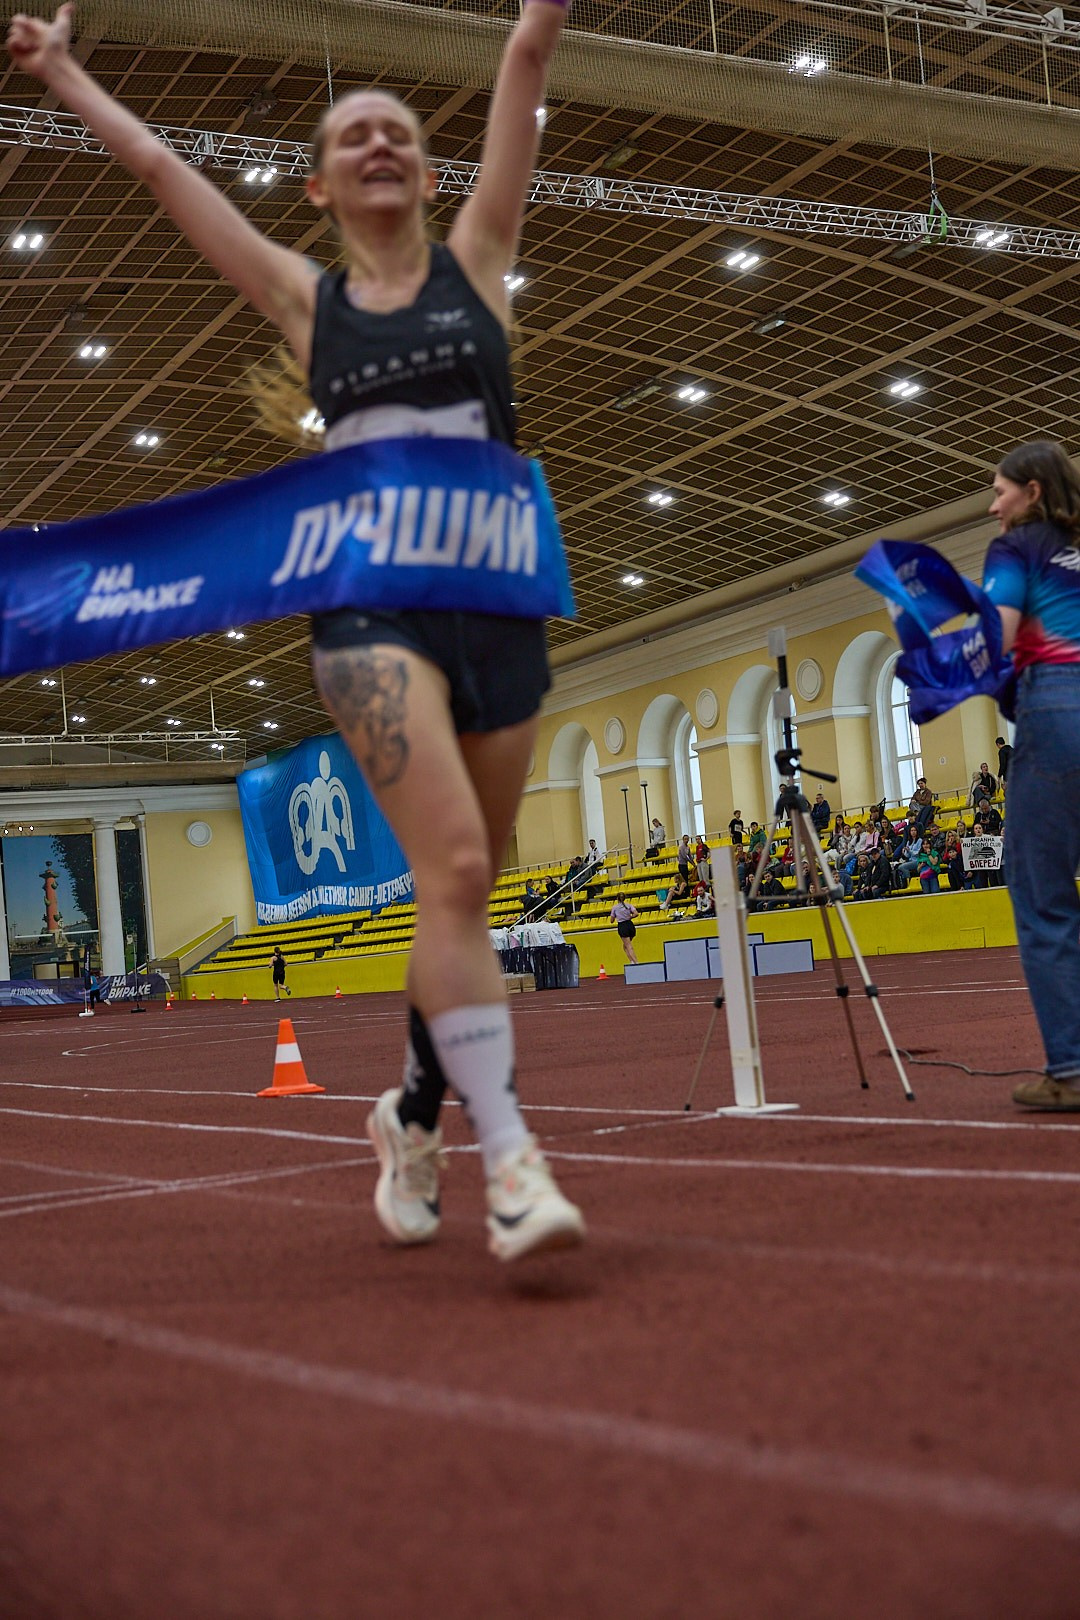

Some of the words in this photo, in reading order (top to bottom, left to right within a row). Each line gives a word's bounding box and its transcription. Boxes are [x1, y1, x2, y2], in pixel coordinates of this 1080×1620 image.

[270, 484, 537, 586] ЛУЧШИЙ
[90, 562, 134, 594] НА
[76, 575, 206, 623] ВИРАЖЕ
[970, 858, 999, 868] ВПЕРЕД!
[112, 976, 126, 987] НА
